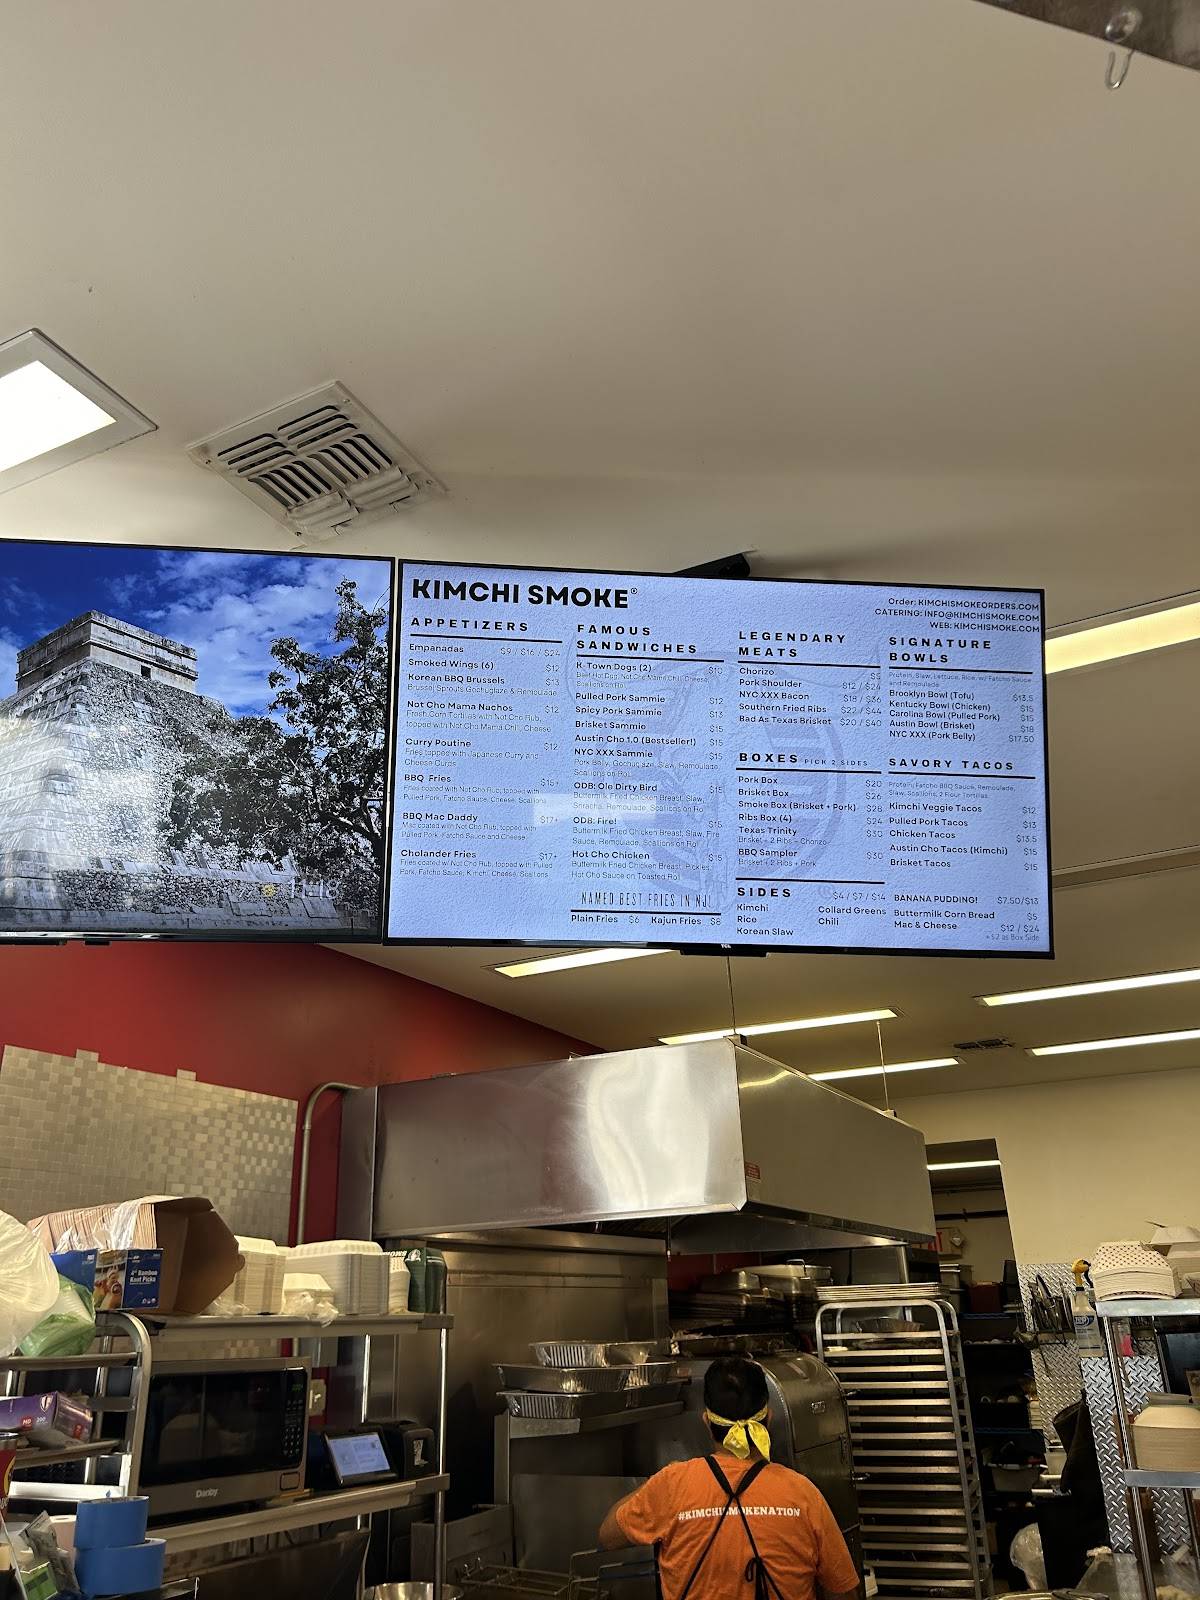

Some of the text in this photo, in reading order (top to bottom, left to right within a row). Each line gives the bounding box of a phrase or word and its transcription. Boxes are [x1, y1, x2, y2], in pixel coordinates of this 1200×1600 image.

[412, 578, 519, 604] KIMCHI
[888, 598, 1038, 610] Order: KIMCHISMOKEORDERS.COM
[874, 608, 1039, 622] CATERING: INFO@KIMCHISMOKE.COM
[411, 617, 528, 631] APPETIZERS
[954, 622, 1039, 633] KIMCHISMOKE.COM
[577, 624, 650, 636] FAMOUS
[739, 631, 845, 644] LEGENDARY
[889, 636, 991, 649] SIGNATURE
[409, 643, 464, 653] Empanadas
[576, 640, 696, 654] SANDWICHES
[738, 646, 797, 658] MEATS
[889, 652, 948, 663] BOWLS
[408, 658, 494, 670] Smoked Wings (6)
[739, 667, 774, 675] Chorizo
[408, 673, 505, 684] Korean BBQ Brussels
[761, 679, 802, 688] Shoulder
[575, 692, 604, 700] Pulled
[629, 694, 665, 703] Sammie
[889, 689, 926, 698] Brooklyn
[950, 691, 974, 700] (Tofu)
[478, 703, 513, 712] Nachos
[575, 706, 600, 715] Spicy
[625, 707, 662, 716] Sammie
[889, 700, 927, 710] Kentucky
[951, 702, 991, 712] (Chicken)
[889, 709, 1000, 722] Carolina Bowl (Pulled Pork)
[575, 720, 646, 730] Brisket Sammie
[889, 720, 916, 728] Austin
[940, 721, 975, 731] (Brisket)
[574, 734, 604, 742] Austin
[928, 731, 950, 740] (Pork
[952, 732, 976, 742] Belly)
[405, 738, 471, 748] Curry Poutine
[596, 748, 615, 756] XXX
[616, 749, 653, 758] Sammie
[739, 752, 797, 763] BOXES
[889, 758, 1013, 770] SAVORY TACOS
[404, 774, 451, 783] BBQ Fries
[615, 783, 637, 792] Dirty
[639, 784, 657, 792] Bird
[738, 788, 770, 796] Brisket
[738, 800, 769, 808] Smoke
[789, 802, 824, 810] (Brisket
[833, 803, 856, 812] Pork)
[889, 802, 982, 813] Kimchi Veggie Tacos
[402, 812, 478, 822] BBQ Mac Daddy
[779, 814, 792, 823] (4)
[889, 817, 917, 825] Pulled
[941, 818, 968, 827] Tacos
[767, 827, 797, 836] Trinity
[889, 829, 956, 839] Chicken Tacos
[400, 849, 476, 858] Cholander Fries
[591, 850, 610, 859] Cho
[611, 851, 650, 859] Chicken
[738, 848, 798, 858] BBQ Sampler
[920, 845, 939, 853] Cho
[940, 845, 968, 853] Tacos
[970, 846, 1008, 856] (Kimchi)
[890, 858, 951, 868] Brisket Tacos
[737, 887, 790, 898] SIDES
[582, 892, 614, 905] NAMED
[619, 892, 642, 906] BEST
[648, 893, 675, 907] FRIES
[680, 894, 690, 907] IN
[894, 894, 978, 904] BANANA PUDDING!
[737, 904, 768, 912] Kimchi
[818, 906, 886, 915] Collard Greens
[571, 914, 618, 923] Plain Fries
[894, 909, 942, 918] Buttermilk
[651, 916, 702, 926] Kajun Fries
[737, 915, 757, 923] Rice
[818, 917, 839, 926] Chili
[923, 921, 957, 930] Cheese
[737, 927, 770, 935] Korean
